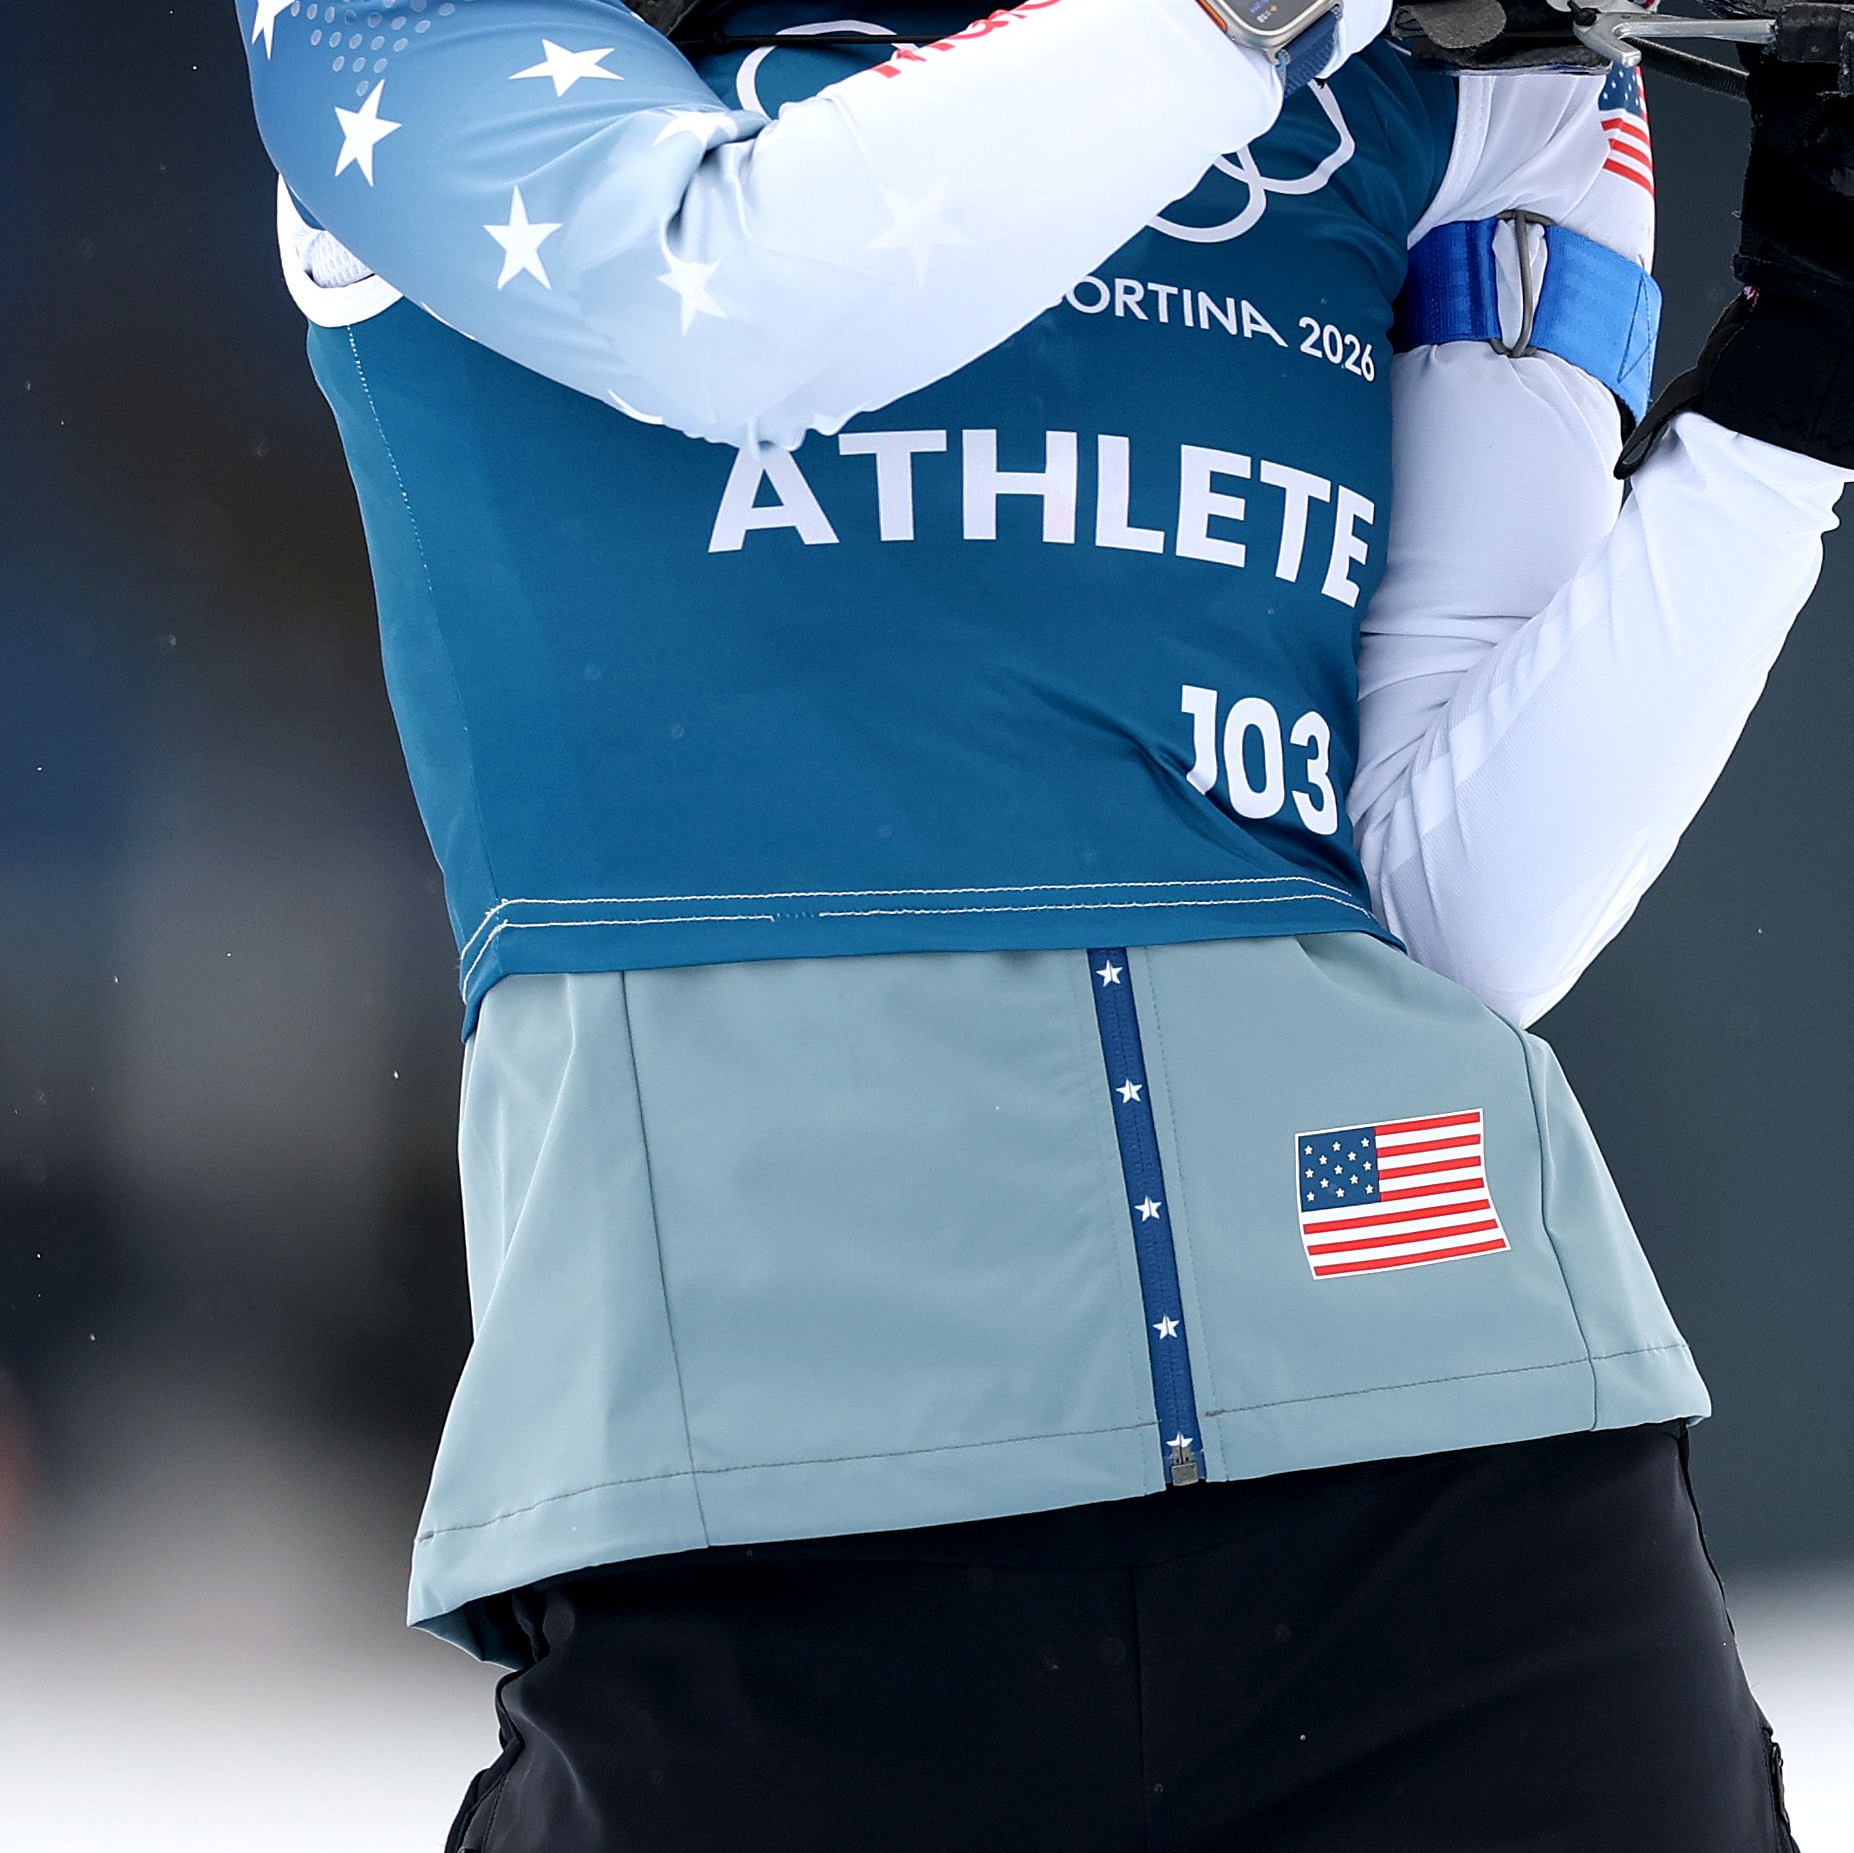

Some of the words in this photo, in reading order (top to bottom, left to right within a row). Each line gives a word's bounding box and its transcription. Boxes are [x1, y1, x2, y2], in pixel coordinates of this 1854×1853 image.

[1050, 275, 1289, 348] ORTINA
[1297, 315, 1376, 383] 2026
[708, 429, 1376, 608] ATHLETE
